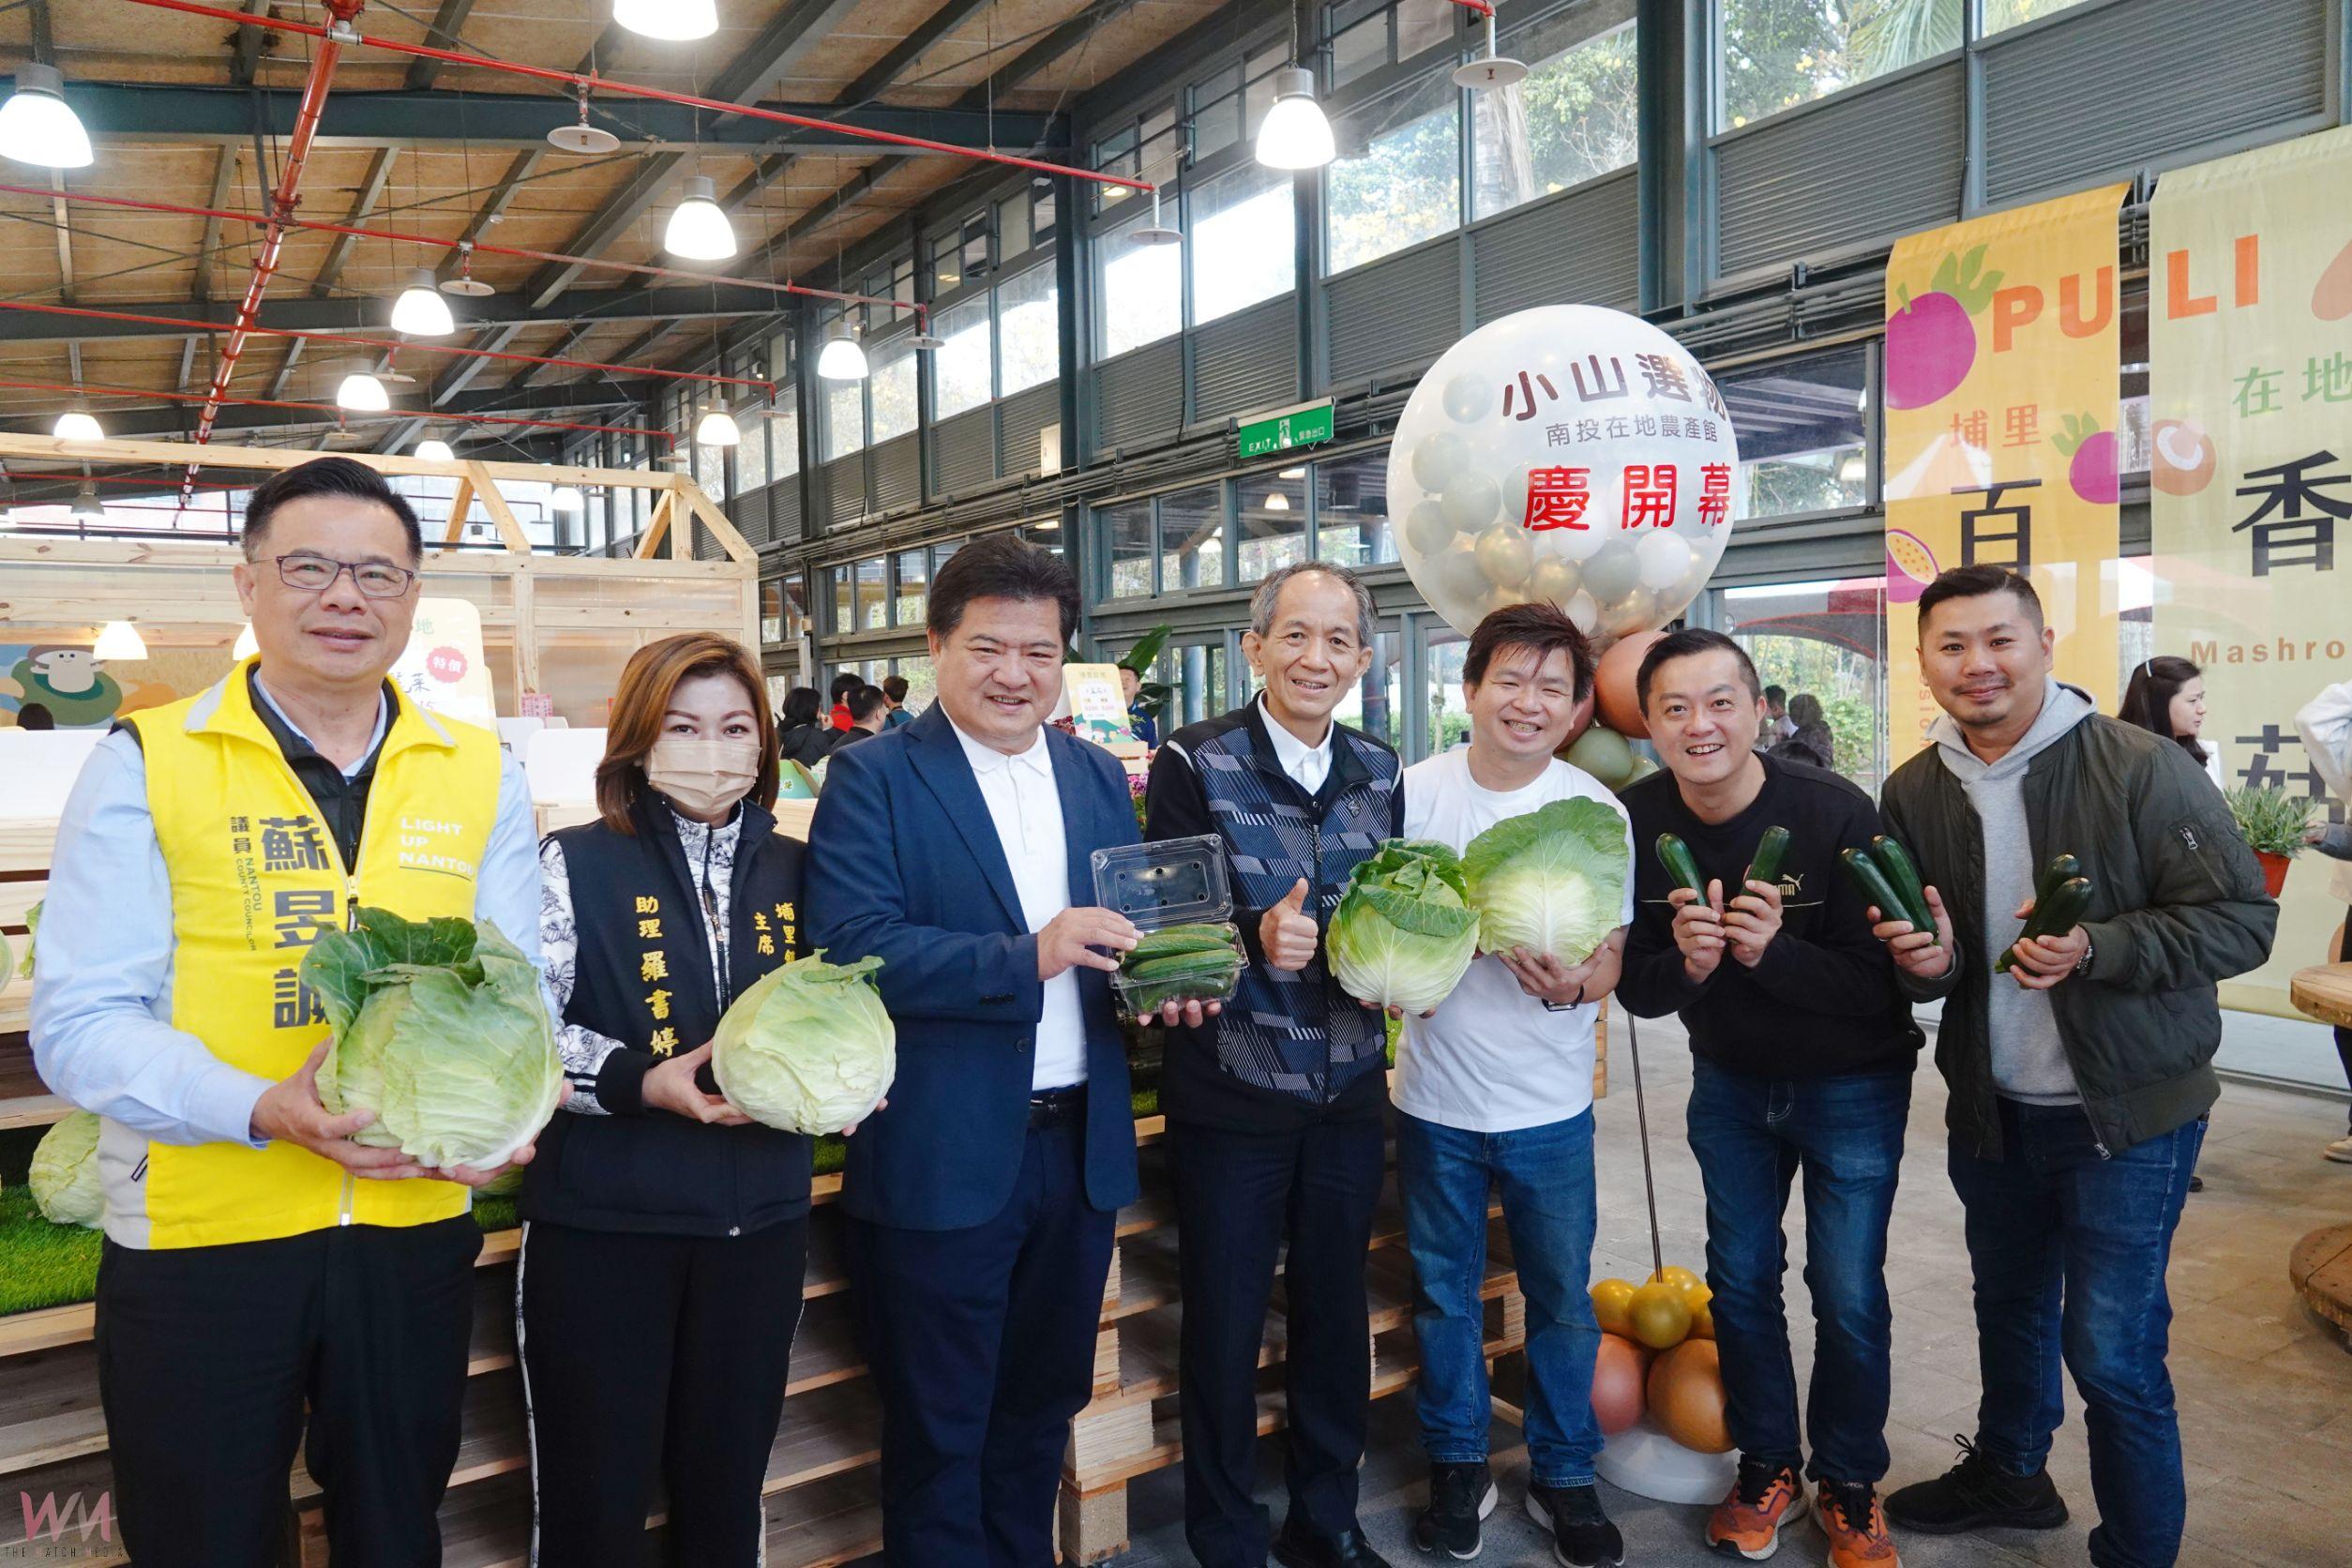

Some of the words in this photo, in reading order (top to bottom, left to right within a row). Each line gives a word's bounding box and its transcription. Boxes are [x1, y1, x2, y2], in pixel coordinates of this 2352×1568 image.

[2166, 234, 2259, 320] LI
[1992, 265, 2113, 354] PU
[1502, 353, 1726, 421] 小山選物
[2232, 351, 2352, 418] 在地
[1248, 437, 1272, 452] EXIT
[1545, 414, 1718, 447] 南投在地農產館
[1950, 403, 2043, 450] 埔里
[1523, 462, 1732, 532] 慶開幕
[1951, 478, 2043, 578] 百
[432, 656, 462, 673] 特價
[2191, 637, 2345, 664] Mashro
[231, 815, 252, 854] 議員
[400, 817, 463, 836] LIGHT
[400, 834, 430, 848] UP
[235, 858, 250, 897] COUNTY
[245, 857, 263, 912] NANTOU
[399, 852, 475, 876] NANTOU
[635, 896, 664, 939] 助理
[754, 912, 775, 957] 主席
[641, 950, 680, 1058] 羅書婷
